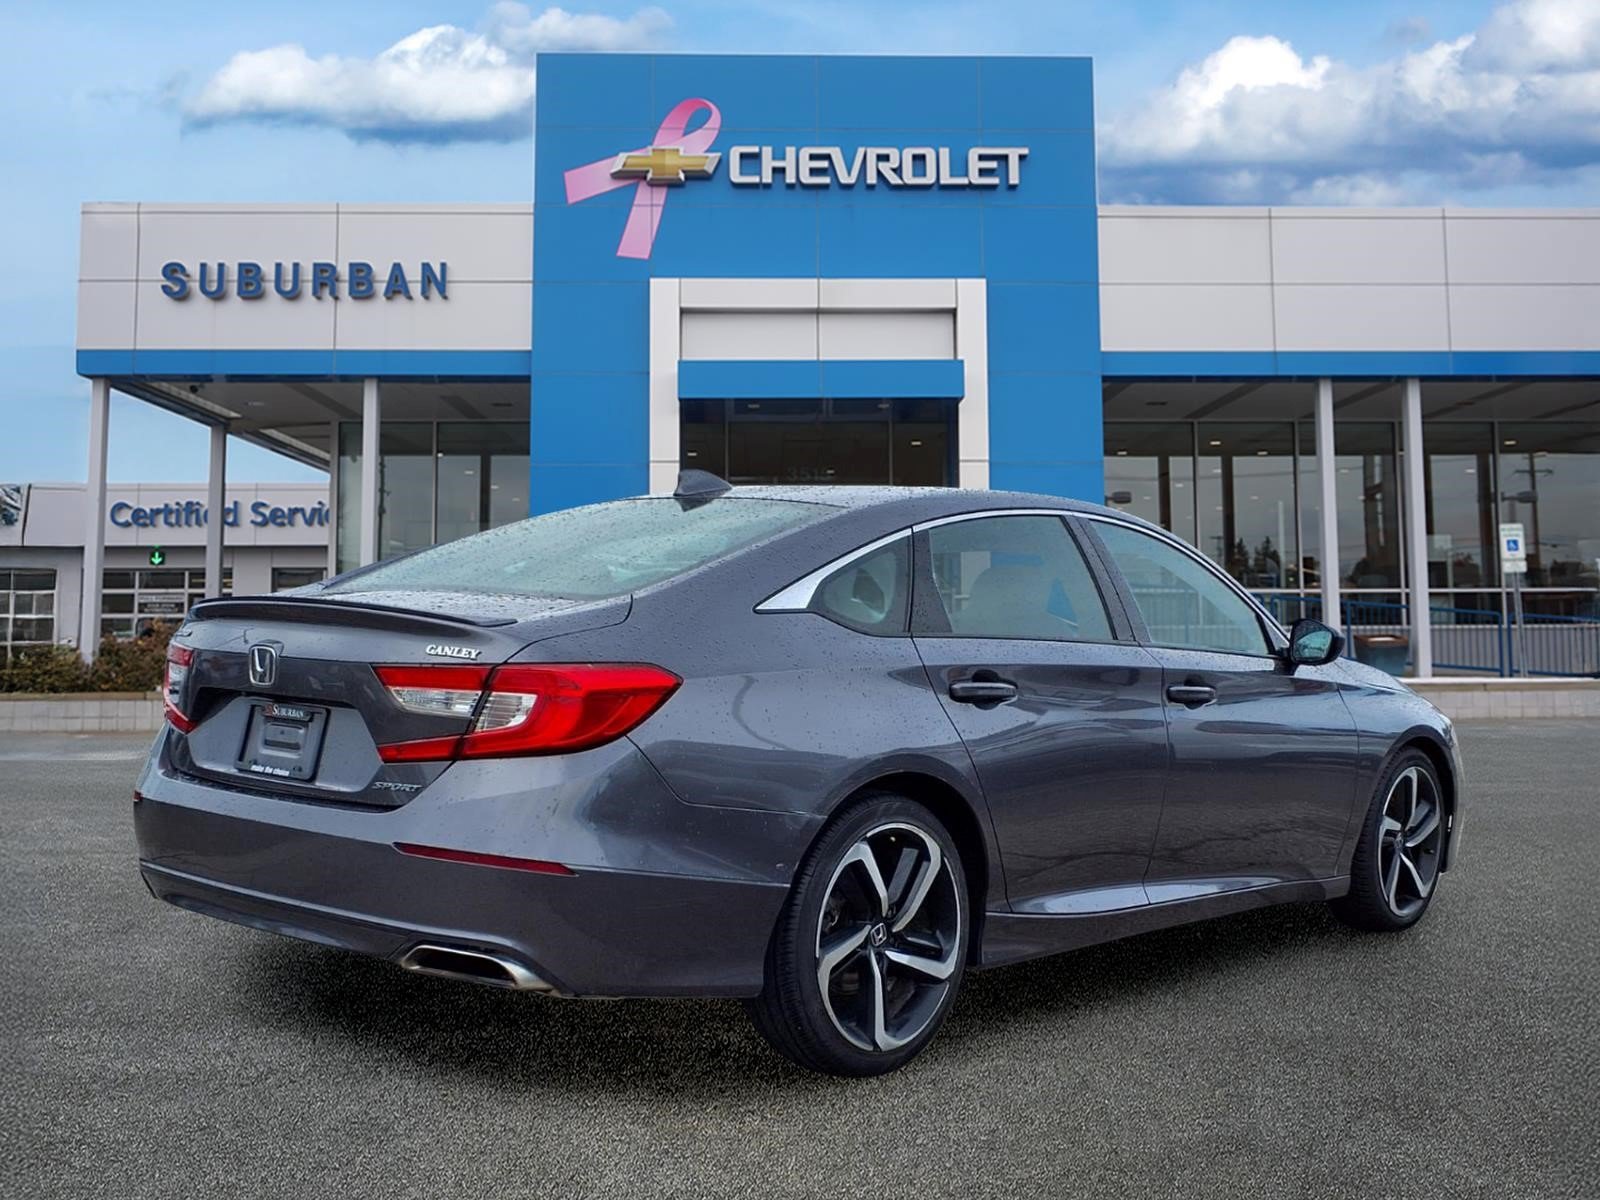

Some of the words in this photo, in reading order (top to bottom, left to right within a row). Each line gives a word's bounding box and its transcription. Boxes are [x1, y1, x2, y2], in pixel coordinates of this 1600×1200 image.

[729, 145, 1029, 187] CHEVROLET
[160, 261, 449, 301] SUBURBAN
[250, 500, 330, 528] Servi
[425, 644, 482, 660] GANLEY
[371, 781, 423, 792] SPORT
